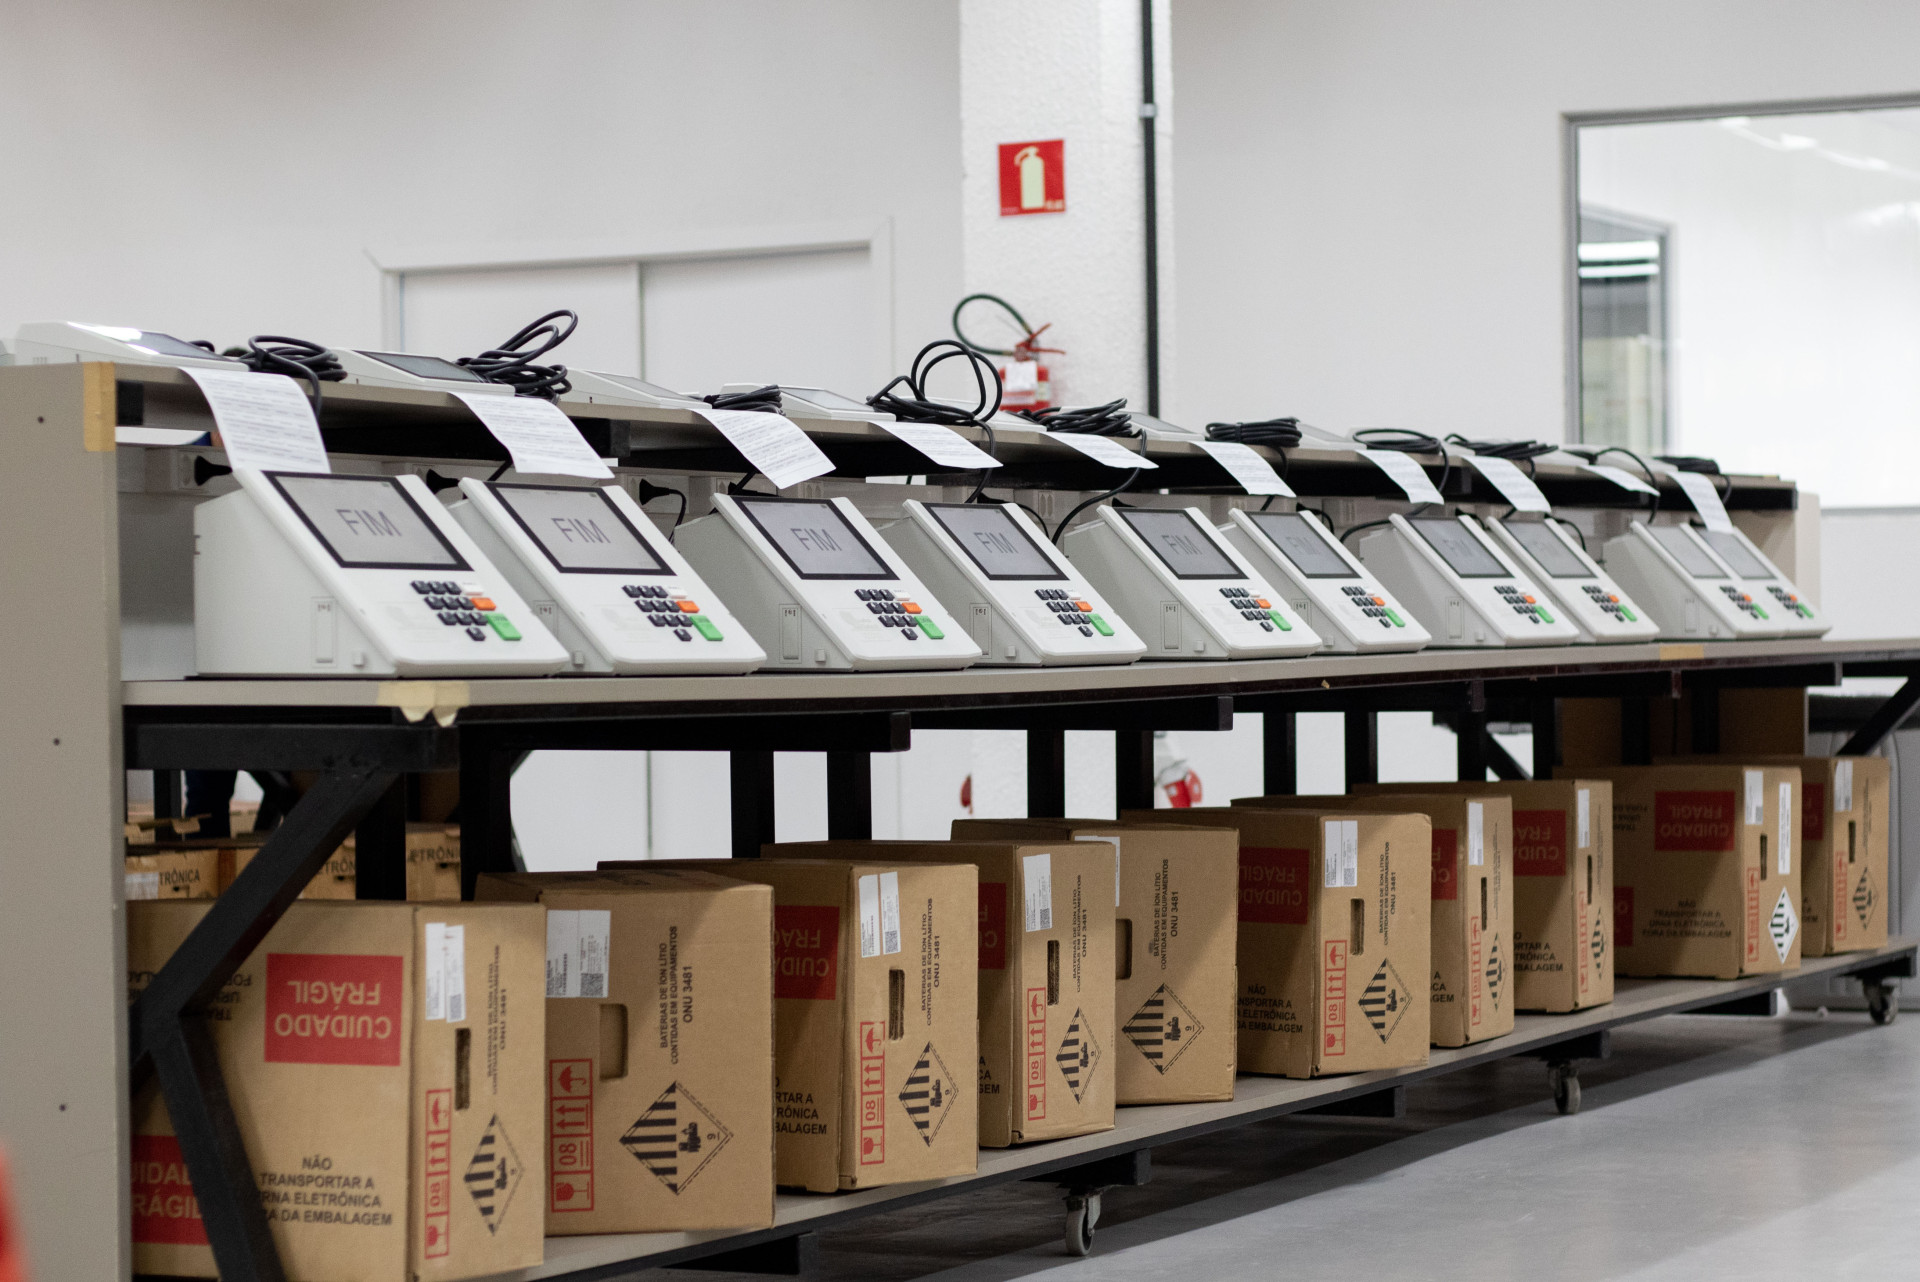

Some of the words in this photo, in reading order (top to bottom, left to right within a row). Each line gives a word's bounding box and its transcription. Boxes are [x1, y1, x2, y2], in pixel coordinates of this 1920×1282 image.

[335, 508, 402, 536] FIM
[551, 518, 611, 543] FIM
[790, 528, 842, 551] FIM
[974, 532, 1019, 553] FIM
[1161, 534, 1202, 554] FIM
[1171, 891, 1179, 912] 3481
[1154, 908, 1160, 918] DE
[1161, 919, 1167, 930] EM
[669, 926, 677, 999] EQUIPAMENTOS
[921, 955, 926, 966] DE
[683, 966, 692, 992] 3481
[927, 966, 932, 980] EM
[1434, 971, 1441, 980] A
[286, 979, 382, 1011] FRÁGIL
[660, 988, 667, 1000] DE
[1248, 984, 1266, 995] NÃO
[669, 1001, 677, 1012] EM
[682, 997, 693, 1023] ONU
[1286, 1000, 1292, 1009] A
[1329, 1004, 1337, 1021] 08
[1243, 1008, 1296, 1021] ELETRÔNICA
[274, 1013, 392, 1039] CUIDADO
[660, 1003, 668, 1048] BATERIAS
[1249, 1021, 1303, 1033] EMBALAGEM
[670, 1018, 678, 1064] CONTIDAS
[1031, 1060, 1039, 1080] 08
[806, 1093, 814, 1104] A
[865, 1100, 876, 1121] 08
[302, 1154, 332, 1171] NÃO
[558, 1142, 577, 1167] 08
[260, 1173, 361, 1190] TRANSPORTAR
[364, 1177, 375, 1190] A
[294, 1190, 381, 1208] ELETRÔNICA
[429, 1182, 441, 1208] 08
[282, 1210, 299, 1222] DA
[304, 1210, 392, 1226] EMBALAGEM
